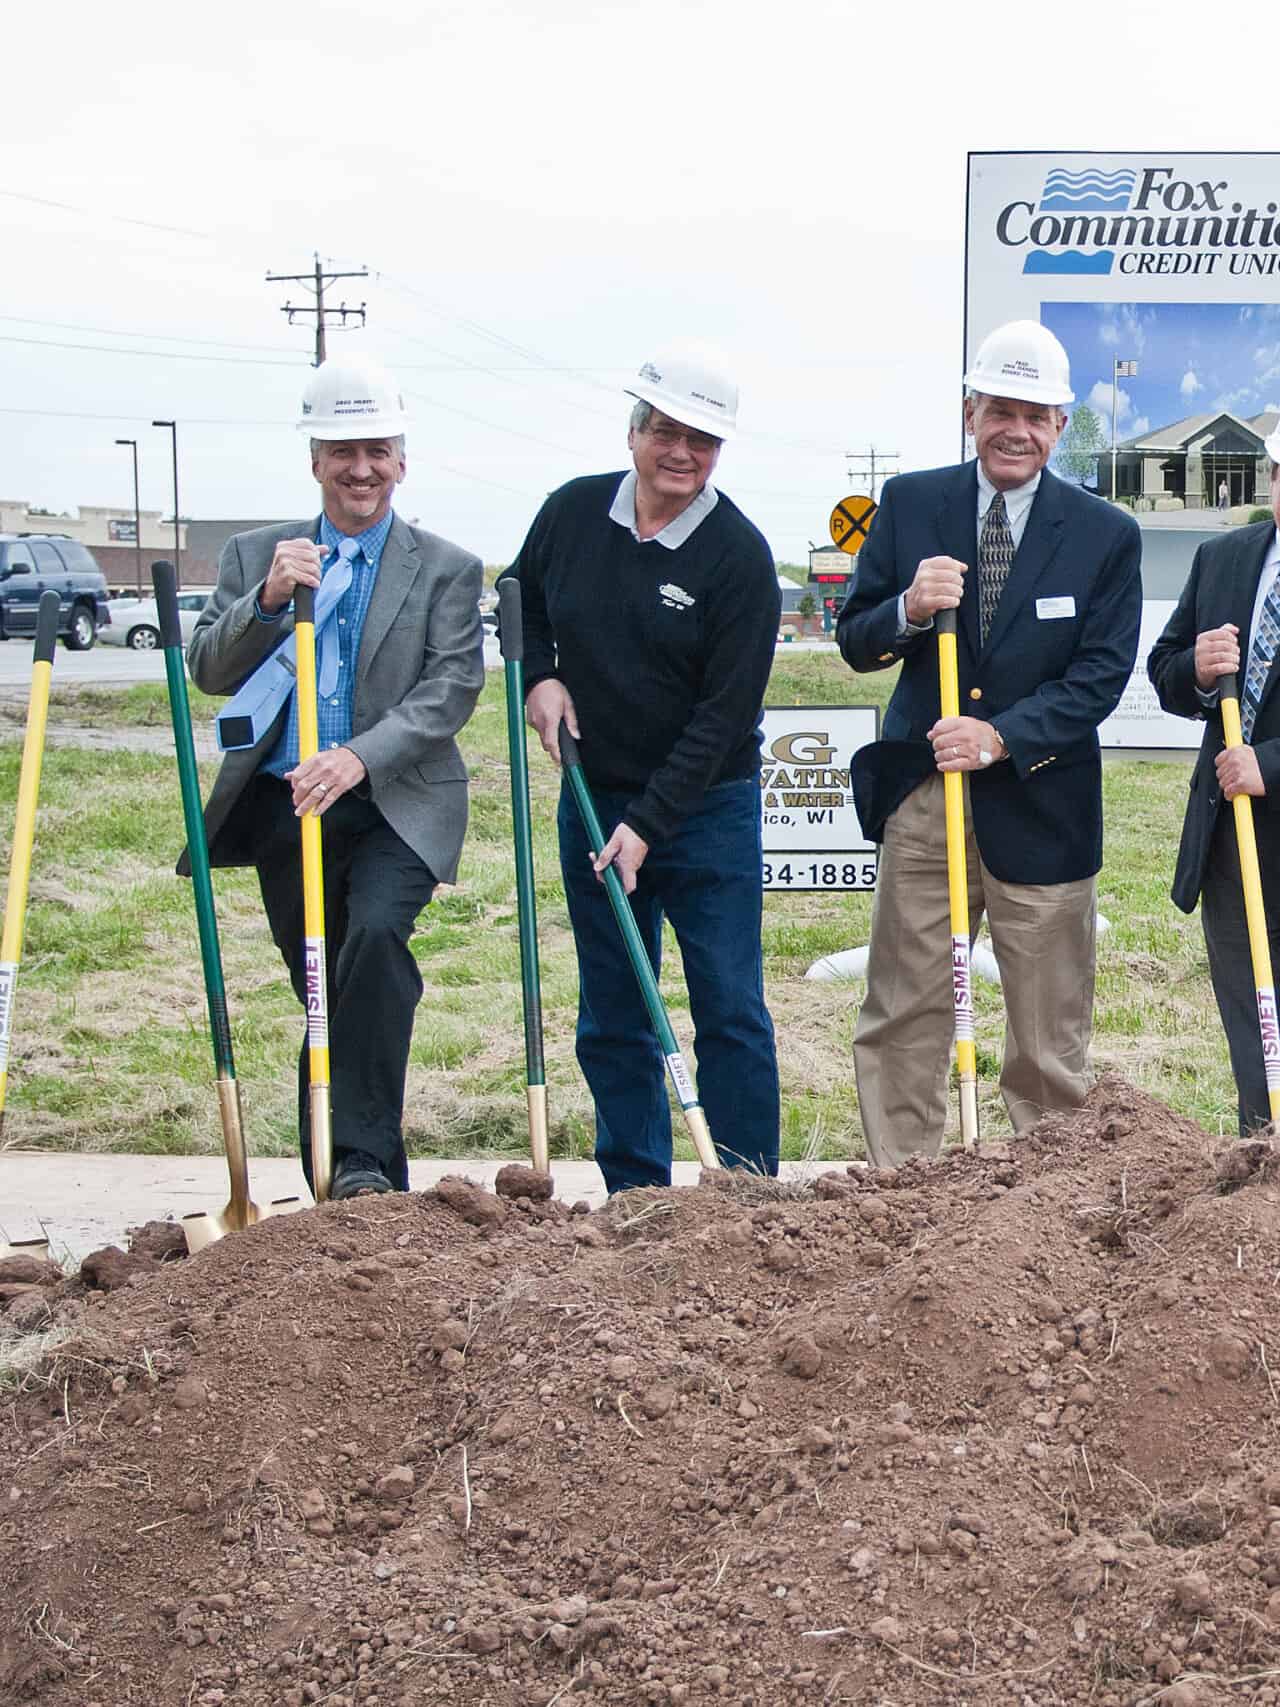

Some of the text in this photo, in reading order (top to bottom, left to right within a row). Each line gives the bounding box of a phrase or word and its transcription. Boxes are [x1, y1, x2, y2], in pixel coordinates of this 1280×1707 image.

[1133, 168, 1228, 211] Fox
[1119, 253, 1220, 275] CREDIT
[761, 732, 838, 766] G
[765, 792, 844, 807] & WATER
[764, 809, 833, 827] ico, WI
[762, 863, 877, 885] 34-1885
[952, 938, 968, 1006] SMET
[1258, 991, 1279, 1056] SMET
[672, 1056, 689, 1086] SMET
